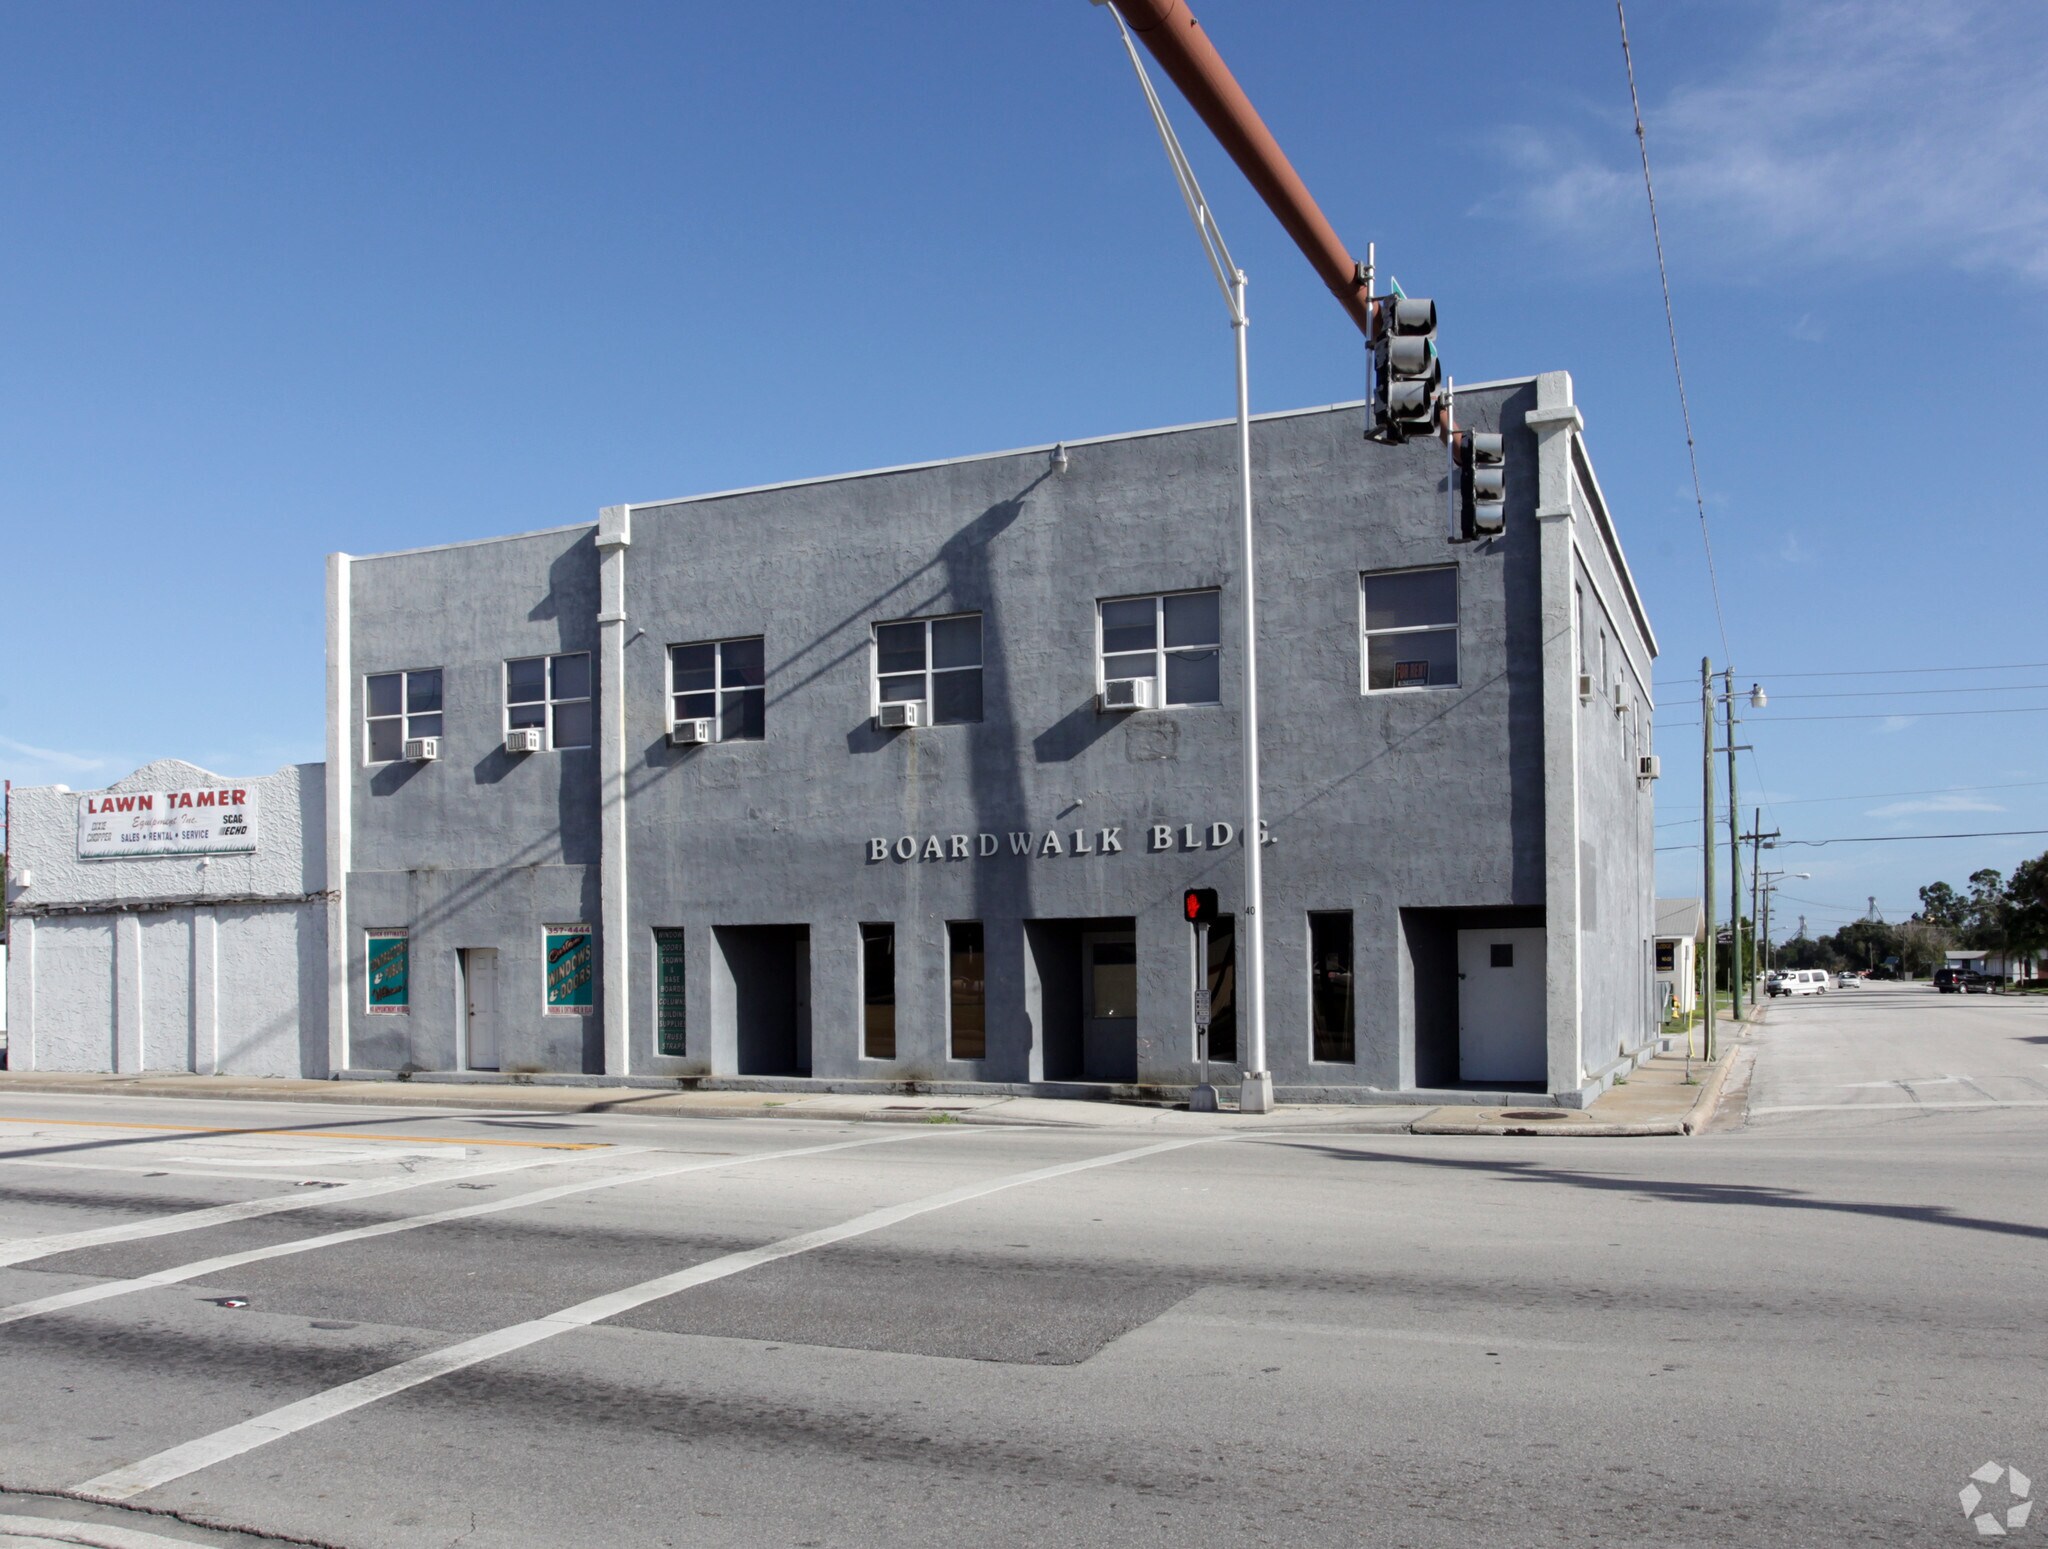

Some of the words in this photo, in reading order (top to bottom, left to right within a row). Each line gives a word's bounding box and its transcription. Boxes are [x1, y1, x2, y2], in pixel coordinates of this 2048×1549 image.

[88, 795, 153, 814] LAWN
[167, 789, 247, 809] TAMER
[132, 816, 178, 830] Equipment
[181, 813, 198, 824] Inc.
[223, 814, 243, 824] SCAG
[121, 833, 140, 843] SALES
[148, 832, 173, 841] RENTAL
[181, 829, 209, 840] SERVICE
[223, 826, 247, 836] ECHO
[86, 832, 112, 843] CHOPPER
[870, 827, 1123, 861] BOARDWALK
[548, 945, 591, 987] WINDOWS
[561, 965, 591, 998] DOORS
[664, 975, 680, 983] BASE
[660, 985, 685, 993] BOARDS
[662, 1042, 685, 1050] STRAPS
